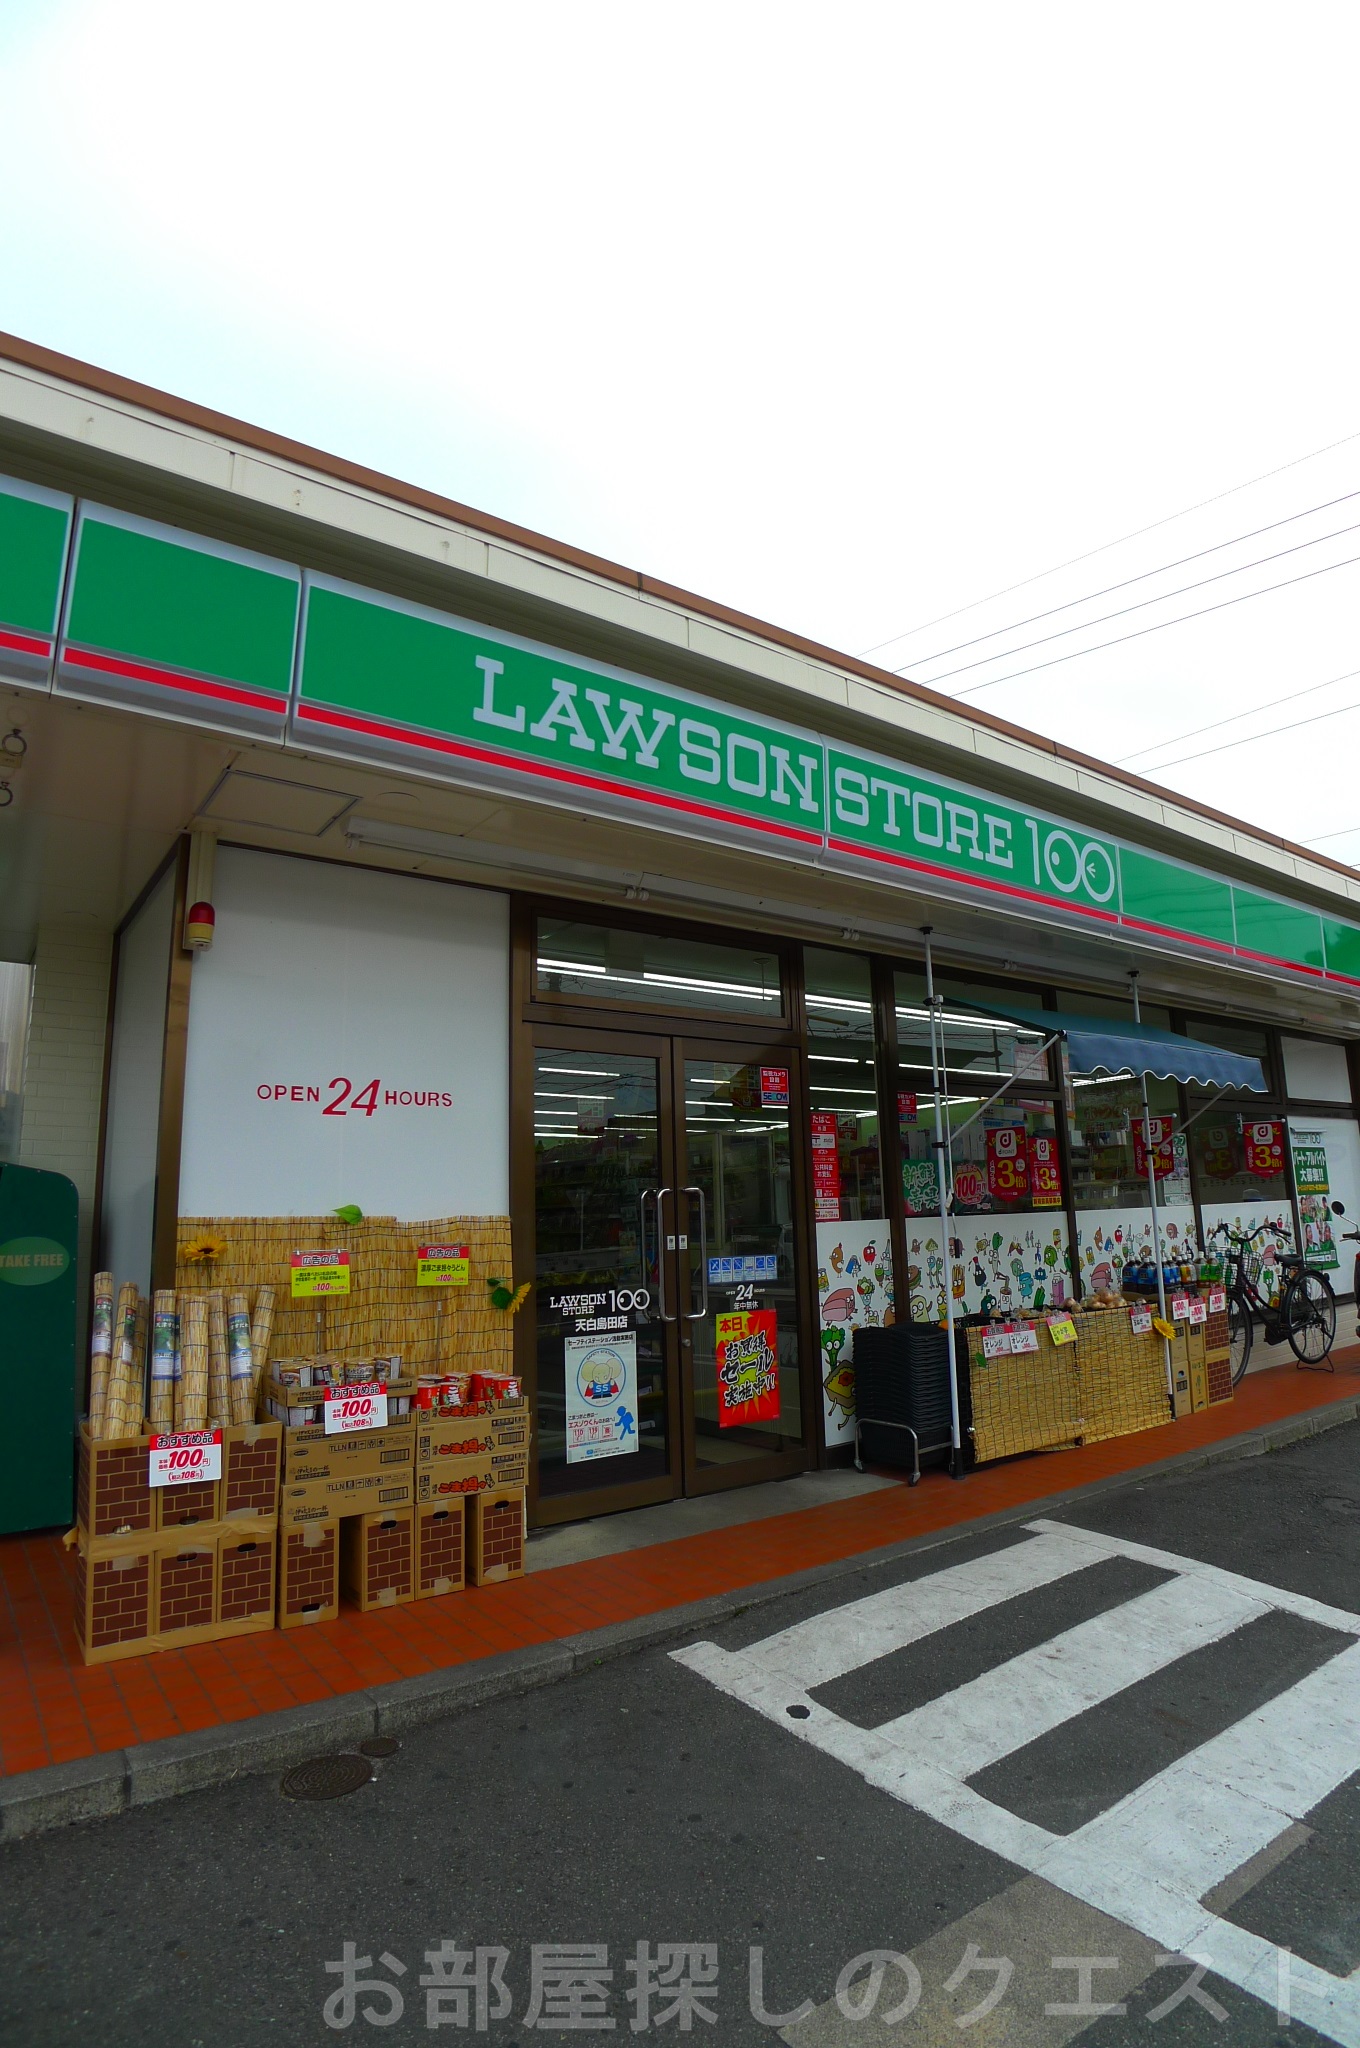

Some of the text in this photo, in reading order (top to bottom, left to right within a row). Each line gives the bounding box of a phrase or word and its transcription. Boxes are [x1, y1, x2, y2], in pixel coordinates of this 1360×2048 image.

[473, 655, 818, 813] LAWSON
[835, 770, 1116, 903] STORE 100
[257, 1077, 452, 1117] OPEN 24 HOURS
[763, 1092, 788, 1101] SECOM
[812, 1115, 831, 1124] たばこ
[0, 1253, 64, 1267] TAKE FREE
[302, 1253, 340, 1267] 広告の品
[427, 1247, 461, 1259] 広告の品
[735, 1283, 754, 1301] 24
[549, 1288, 651, 1313] LAWSON 100
[733, 1301, 759, 1311] 年中無休
[562, 1305, 595, 1316] STORE
[575, 1315, 628, 1333] 天白島田店
[719, 1316, 743, 1333] 本日
[725, 1330, 767, 1360] お買得
[984, 1338, 1003, 1349] オレンジ
[1011, 1335, 1029, 1345] オレンジ
[720, 1347, 775, 1384] セール
[331, 1383, 380, 1399] おすすめ品
[595, 1384, 609, 1393] SS
[724, 1373, 776, 1407] 実施中!!
[157, 1432, 214, 1448] おすすめ品
